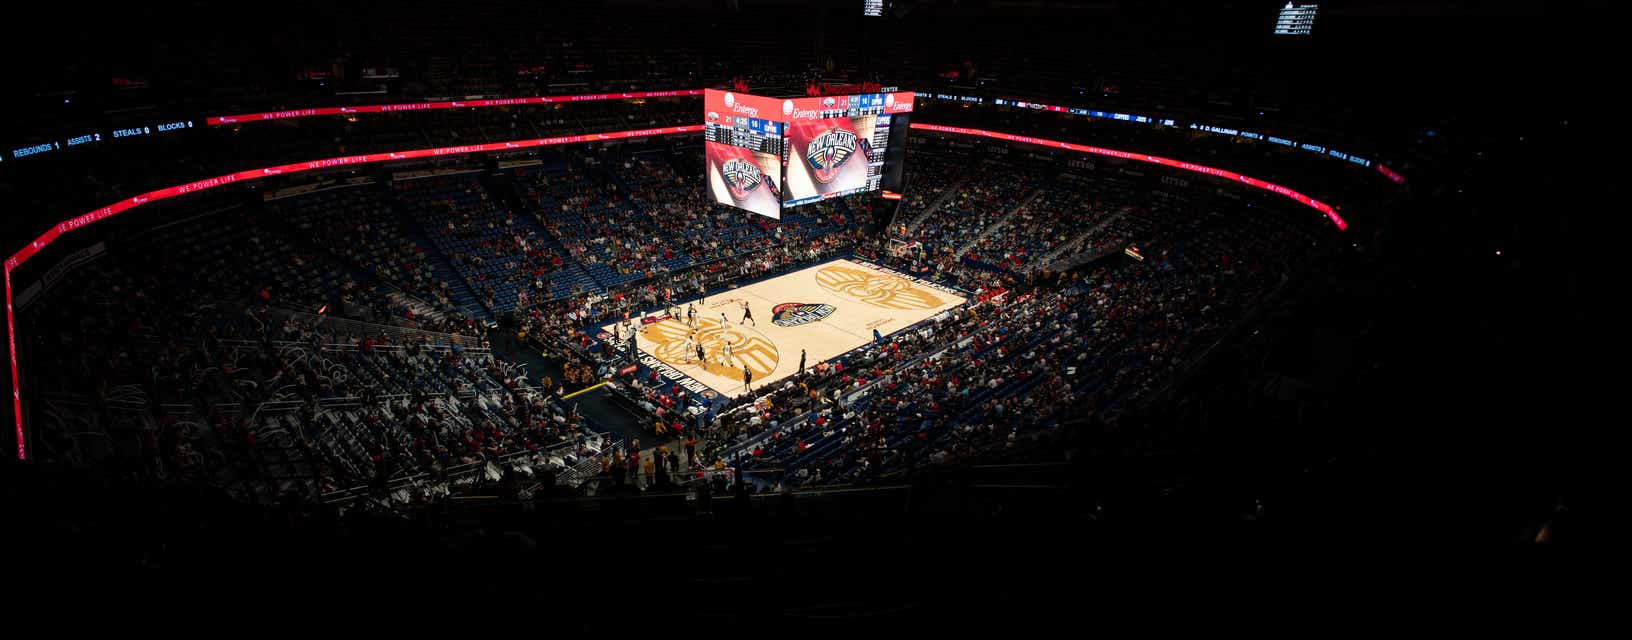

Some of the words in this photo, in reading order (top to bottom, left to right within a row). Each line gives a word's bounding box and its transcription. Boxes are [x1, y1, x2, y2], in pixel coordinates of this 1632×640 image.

[734, 102, 759, 118] Entergy
[893, 101, 912, 112] Entergy
[276, 110, 300, 118] POWER
[302, 108, 315, 116] LIFE
[793, 108, 818, 120] Entergy
[112, 127, 142, 138] STEALS
[144, 126, 150, 134] 0
[157, 122, 185, 132] BLOCKS
[187, 120, 193, 128] 0
[1211, 127, 1238, 136] GALLINARI
[67, 134, 92, 146] ASSISTS
[94, 133, 101, 141] 2
[1240, 131, 1258, 139] POINTS
[1268, 136, 1292, 146] REBOUNDS
[808, 134, 825, 154] NEW
[825, 131, 857, 150] ORLEANS
[1301, 143, 1322, 152] ASSISTS
[12, 143, 52, 158] REBOUNDS
[54, 141, 60, 150] 1
[446, 146, 469, 154] POWER
[309, 161, 320, 169] WE
[323, 157, 349, 166] POWER
[736, 162, 761, 180] ORLEANS
[178, 185, 190, 193] WE
[193, 178, 219, 189] POWER
[221, 175, 235, 184] LIFE
[69, 214, 95, 229] POWER
[97, 208, 112, 219] LIFE
[639, 356, 683, 381] ORLEANS
[676, 378, 707, 394] NEW
